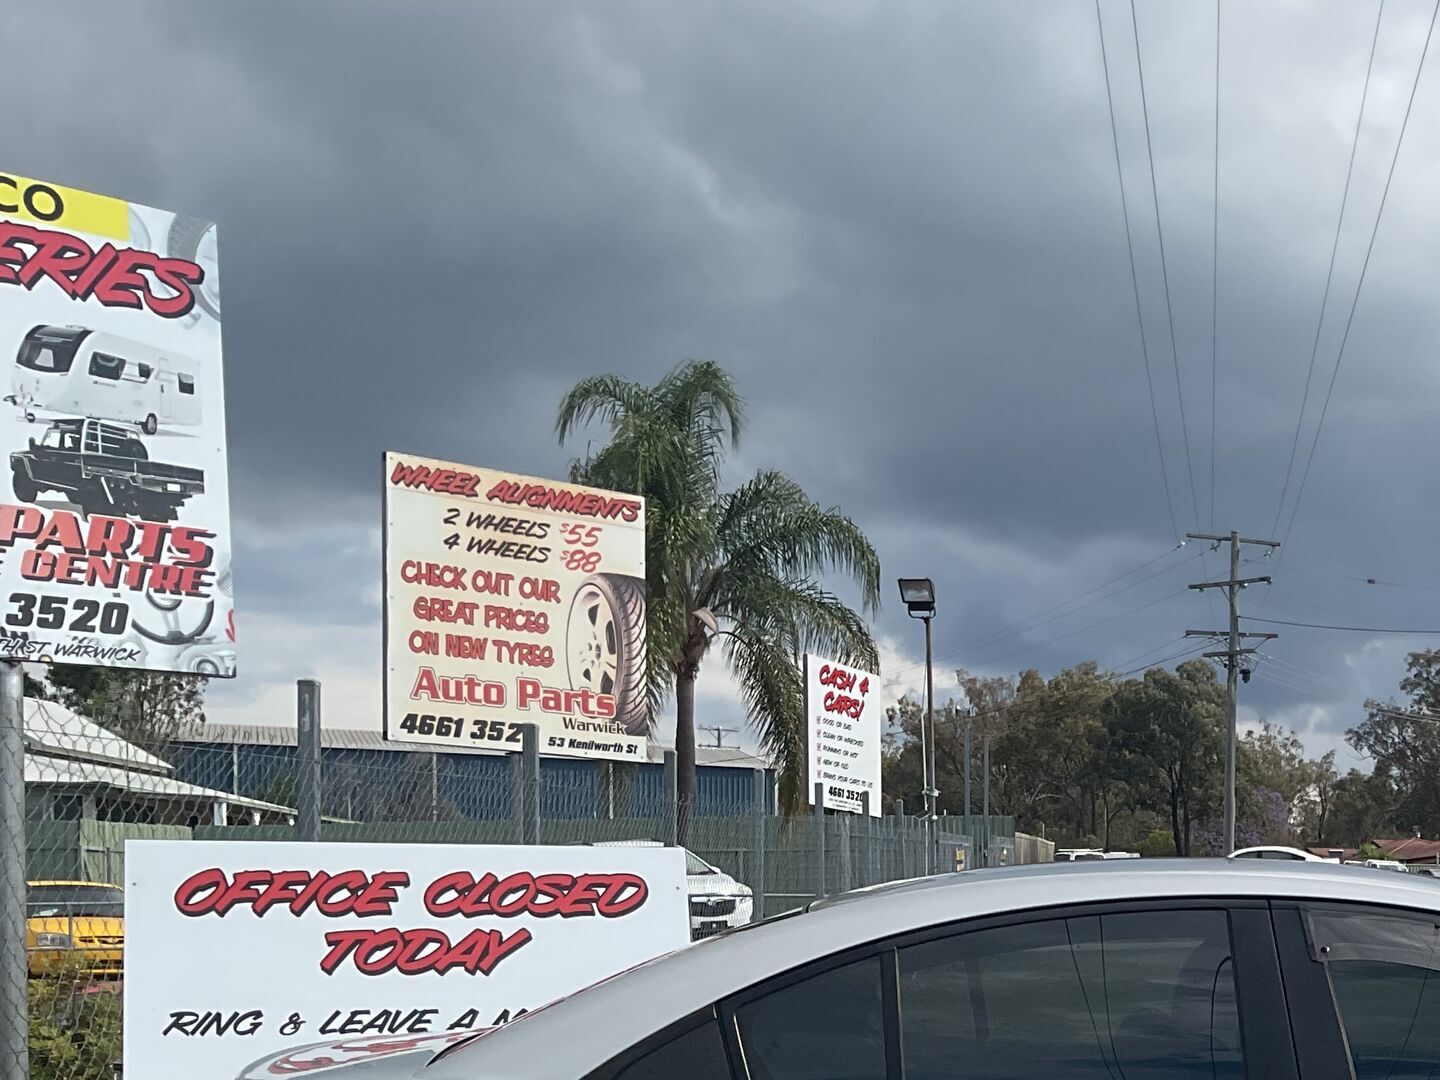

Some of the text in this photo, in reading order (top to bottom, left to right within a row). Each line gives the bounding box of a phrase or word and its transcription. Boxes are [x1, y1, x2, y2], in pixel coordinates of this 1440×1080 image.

[391, 462, 642, 523] WHEEL ALIGNMENTS
[0, 504, 216, 568] PARTS
[443, 508, 602, 547] 2 WHEELS $55
[443, 533, 602, 573] 4 WHEELS $88
[21, 549, 216, 598] CENTRE
[401, 560, 562, 604] CHECK OUT OUR
[5, 592, 129, 635] 3520
[413, 596, 550, 634] GREAT PRICES
[25, 640, 52, 654] ST
[54, 643, 141, 661] WARWICK
[408, 629, 555, 668] ON NEW TYRES
[411, 666, 617, 719] Auto Parts
[819, 664, 869, 697] CASH 4
[824, 691, 865, 721] CARS!
[400, 713, 524, 743] 4661 352
[548, 737, 638, 754] 53 Kenilworth St
[562, 717, 628, 735] Warwick
[829, 786, 845, 798] 4661
[175, 868, 649, 918] OFFICE CLOSED
[320, 927, 533, 976] TODAY
[162, 1010, 264, 1037] RING
[279, 1012, 306, 1036] &
[318, 1009, 439, 1035] LEAVE
[446, 1007, 480, 1031] A
